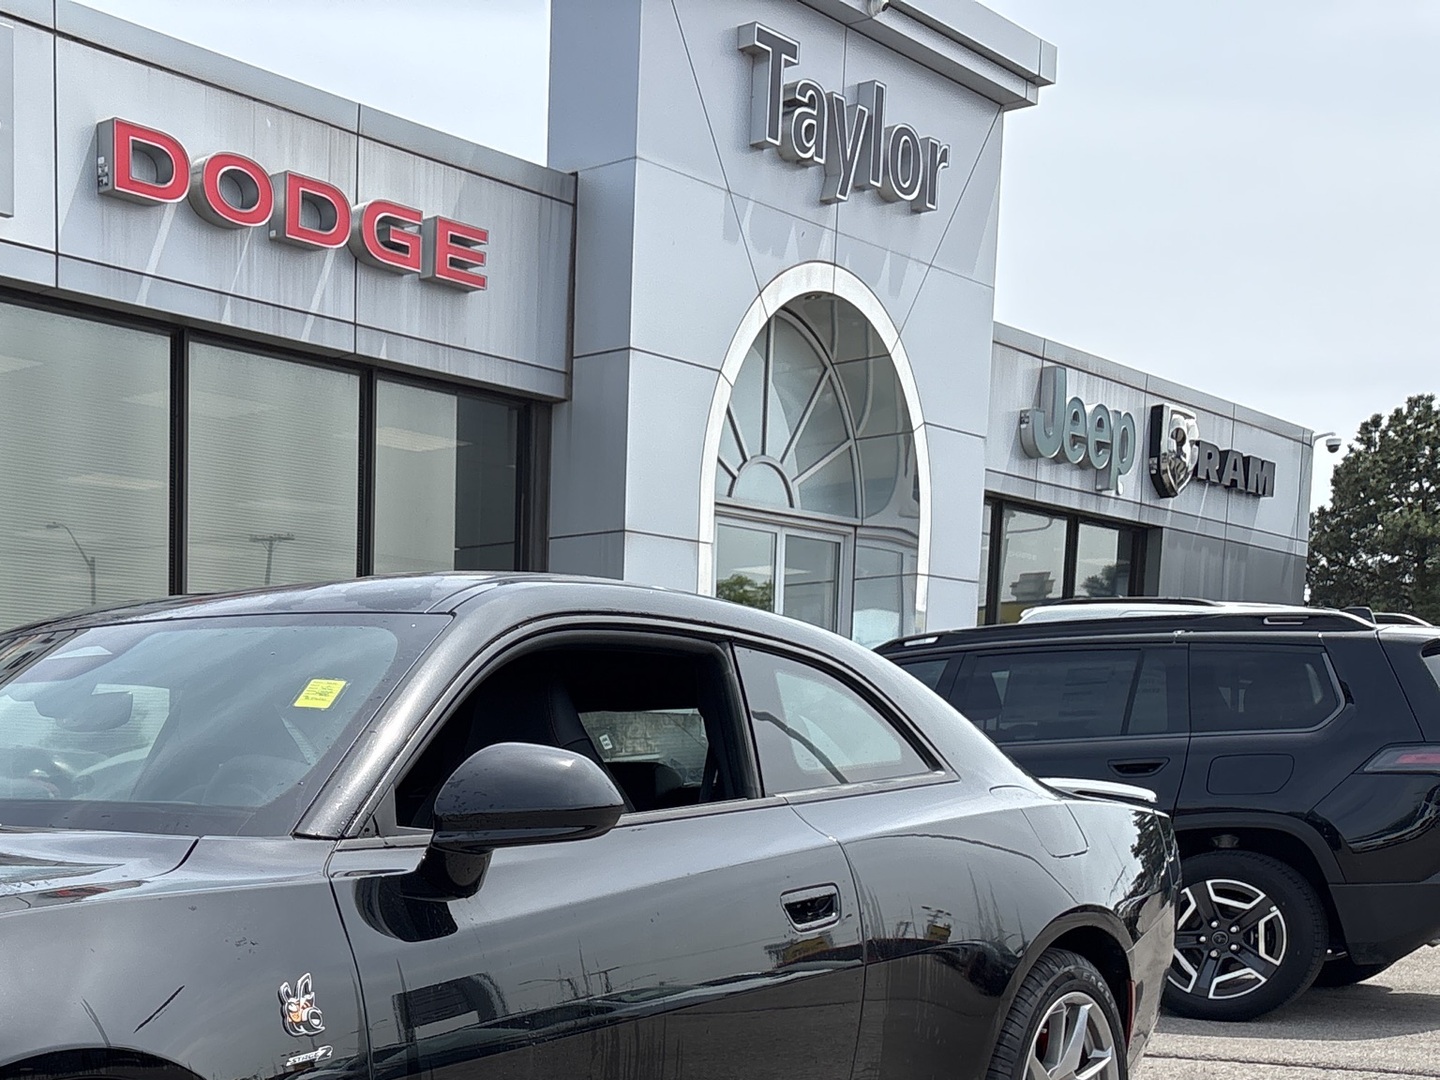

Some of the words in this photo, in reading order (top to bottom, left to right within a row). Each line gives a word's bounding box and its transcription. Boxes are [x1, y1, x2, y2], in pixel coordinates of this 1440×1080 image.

[737, 21, 950, 211] Taylor
[97, 117, 489, 291] DODGE
[1020, 366, 1136, 495] Jeep
[1194, 440, 1276, 497] RAM
